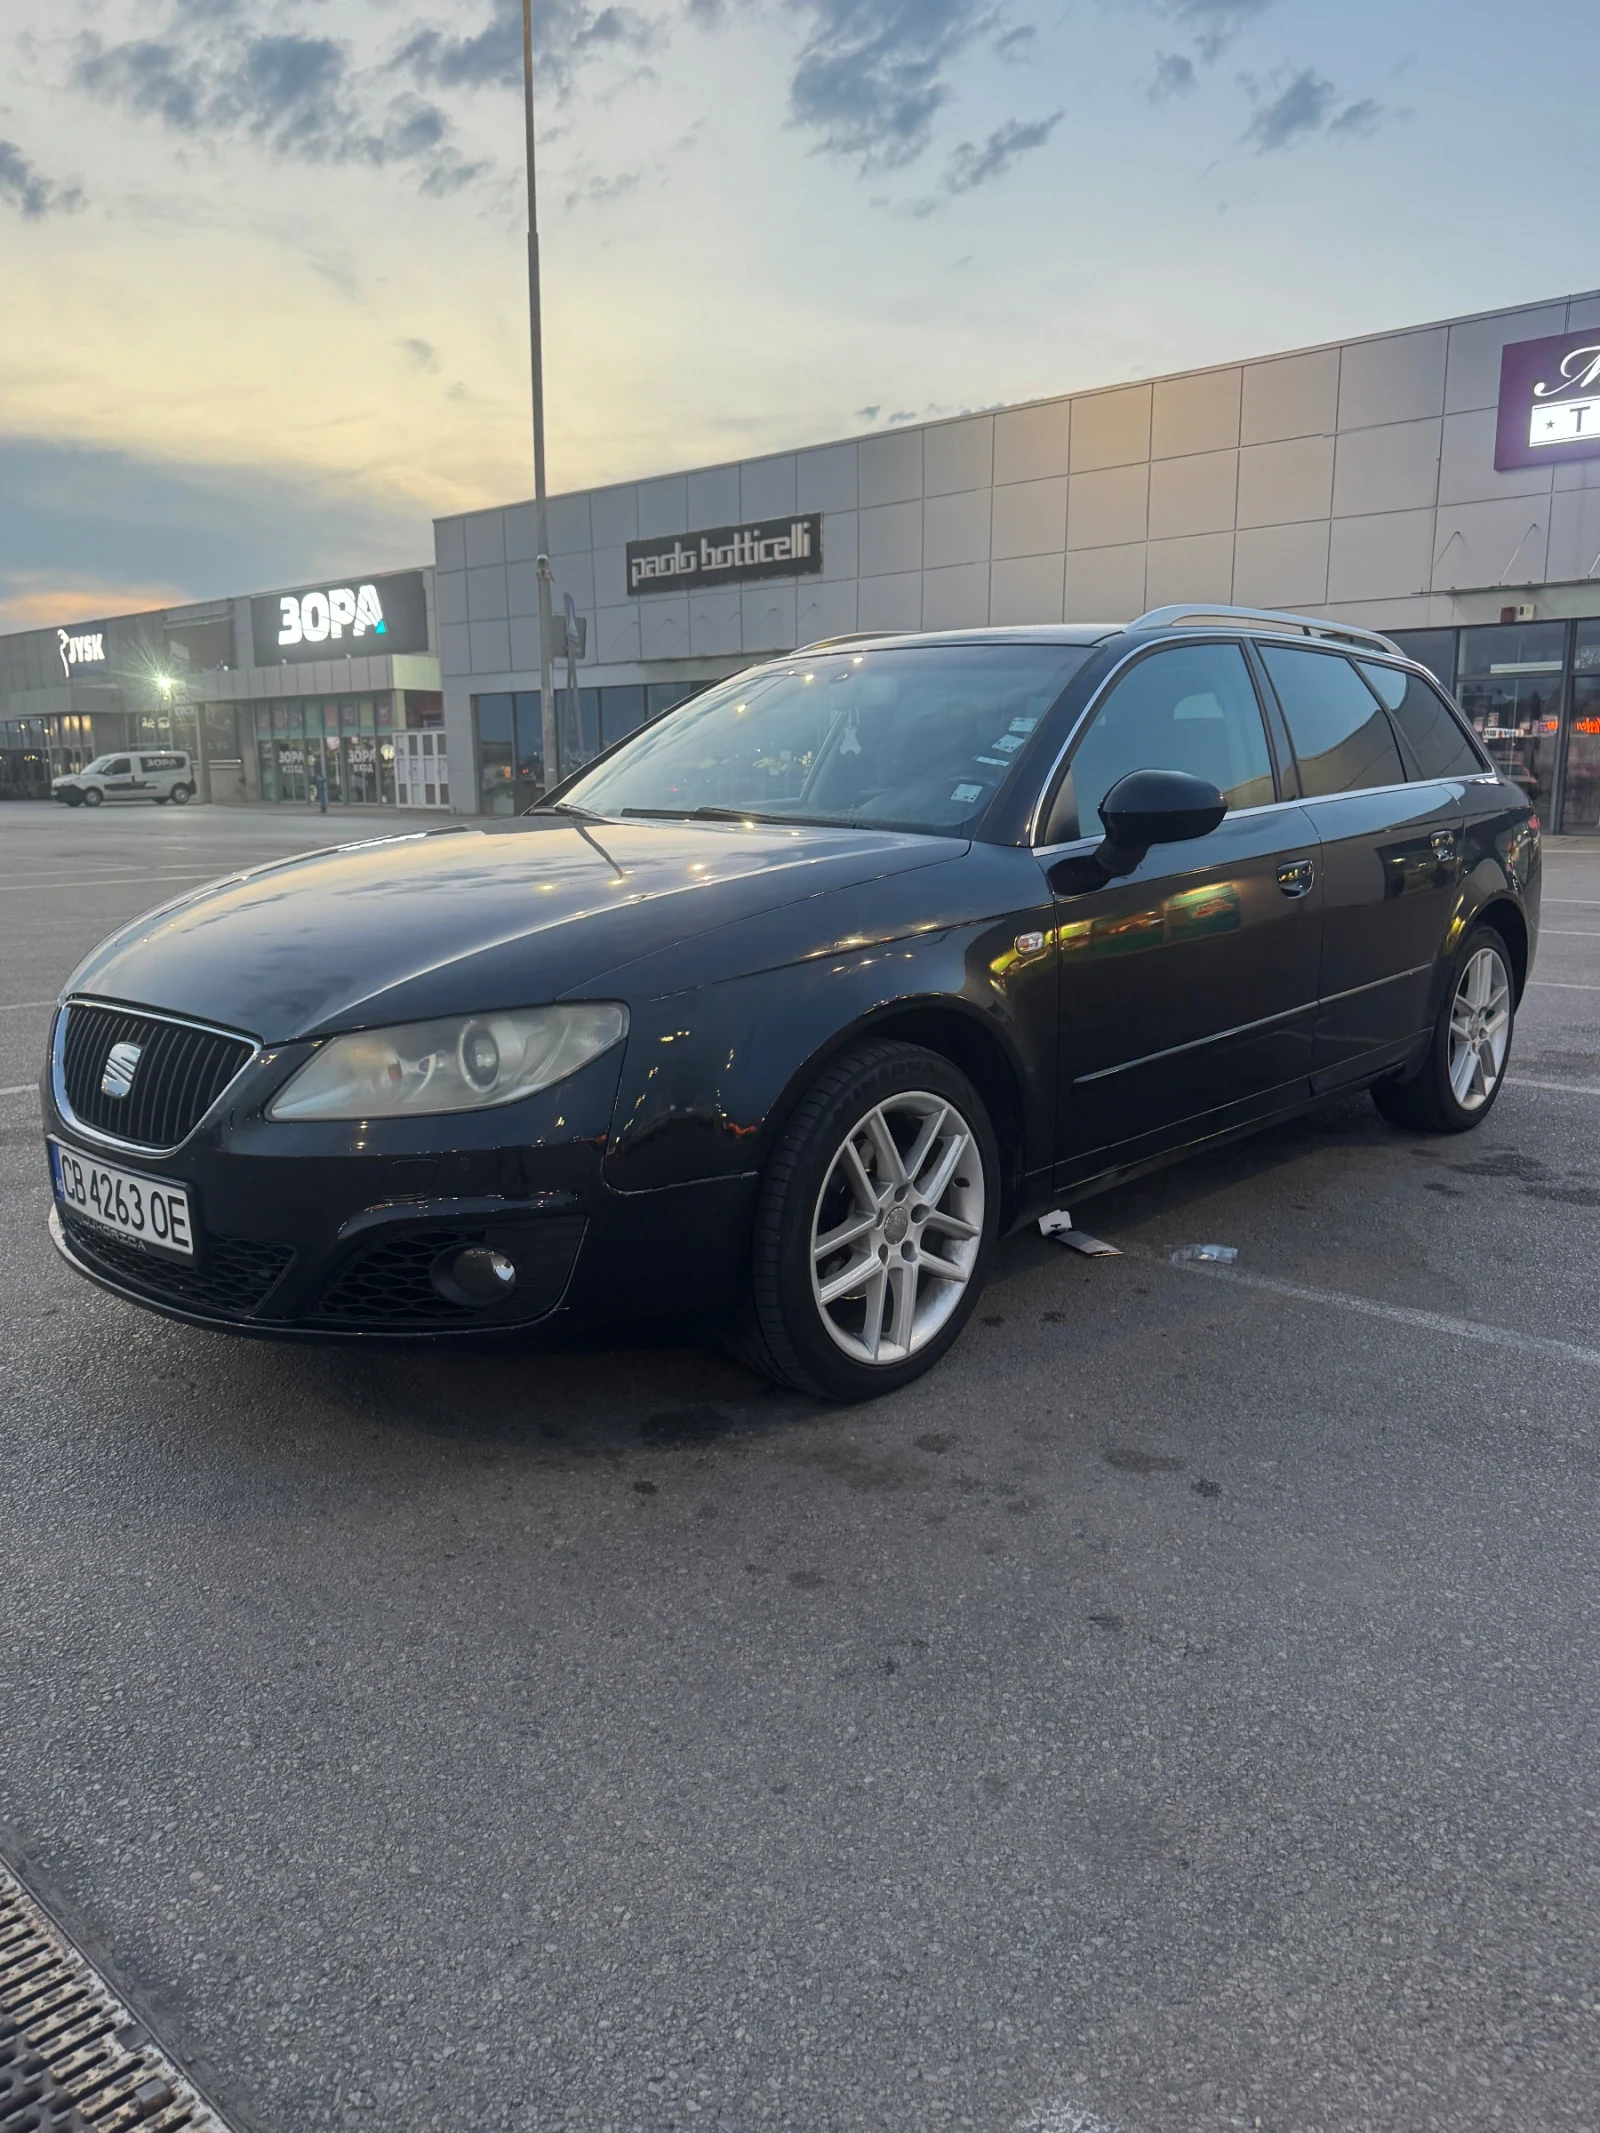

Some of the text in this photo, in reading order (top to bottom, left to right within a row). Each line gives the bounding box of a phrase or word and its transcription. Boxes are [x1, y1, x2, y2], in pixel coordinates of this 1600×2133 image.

[631, 521, 811, 587] paolo botticelli
[278, 584, 387, 646] ЗОРА
[68, 633, 106, 664] JYSK
[61, 1153, 87, 1206] CB
[90, 1168, 146, 1232] 4263
